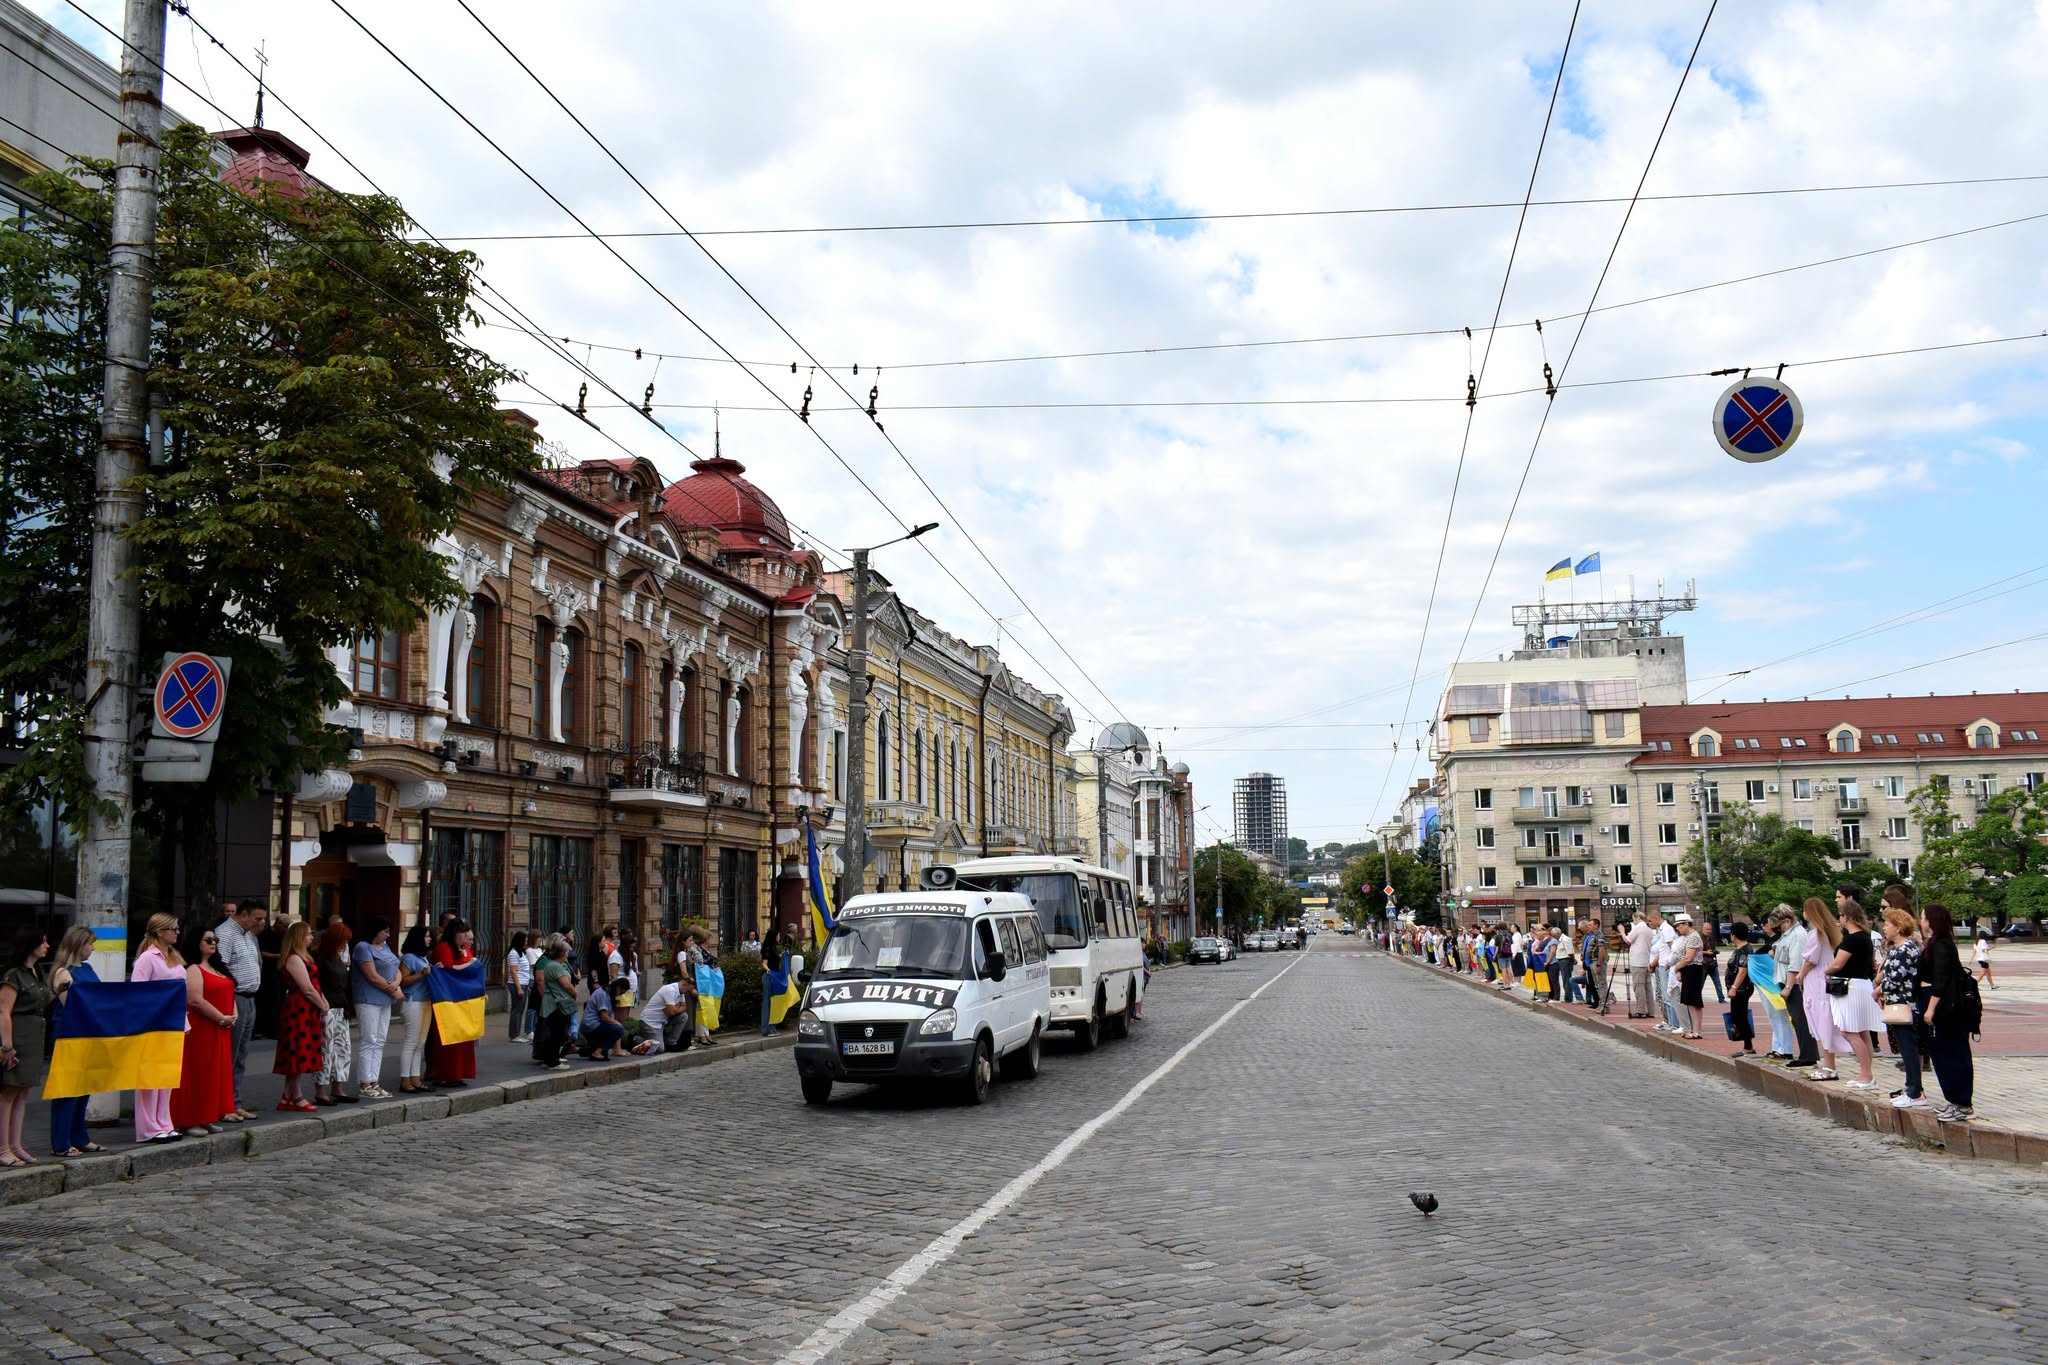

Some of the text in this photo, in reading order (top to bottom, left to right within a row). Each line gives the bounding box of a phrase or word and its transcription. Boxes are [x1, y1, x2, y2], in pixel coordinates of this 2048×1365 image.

[1601, 897, 1641, 906] GOGOL
[896, 904, 965, 914] ВМИРАЮТЬ
[861, 1043, 879, 1053] 1628
